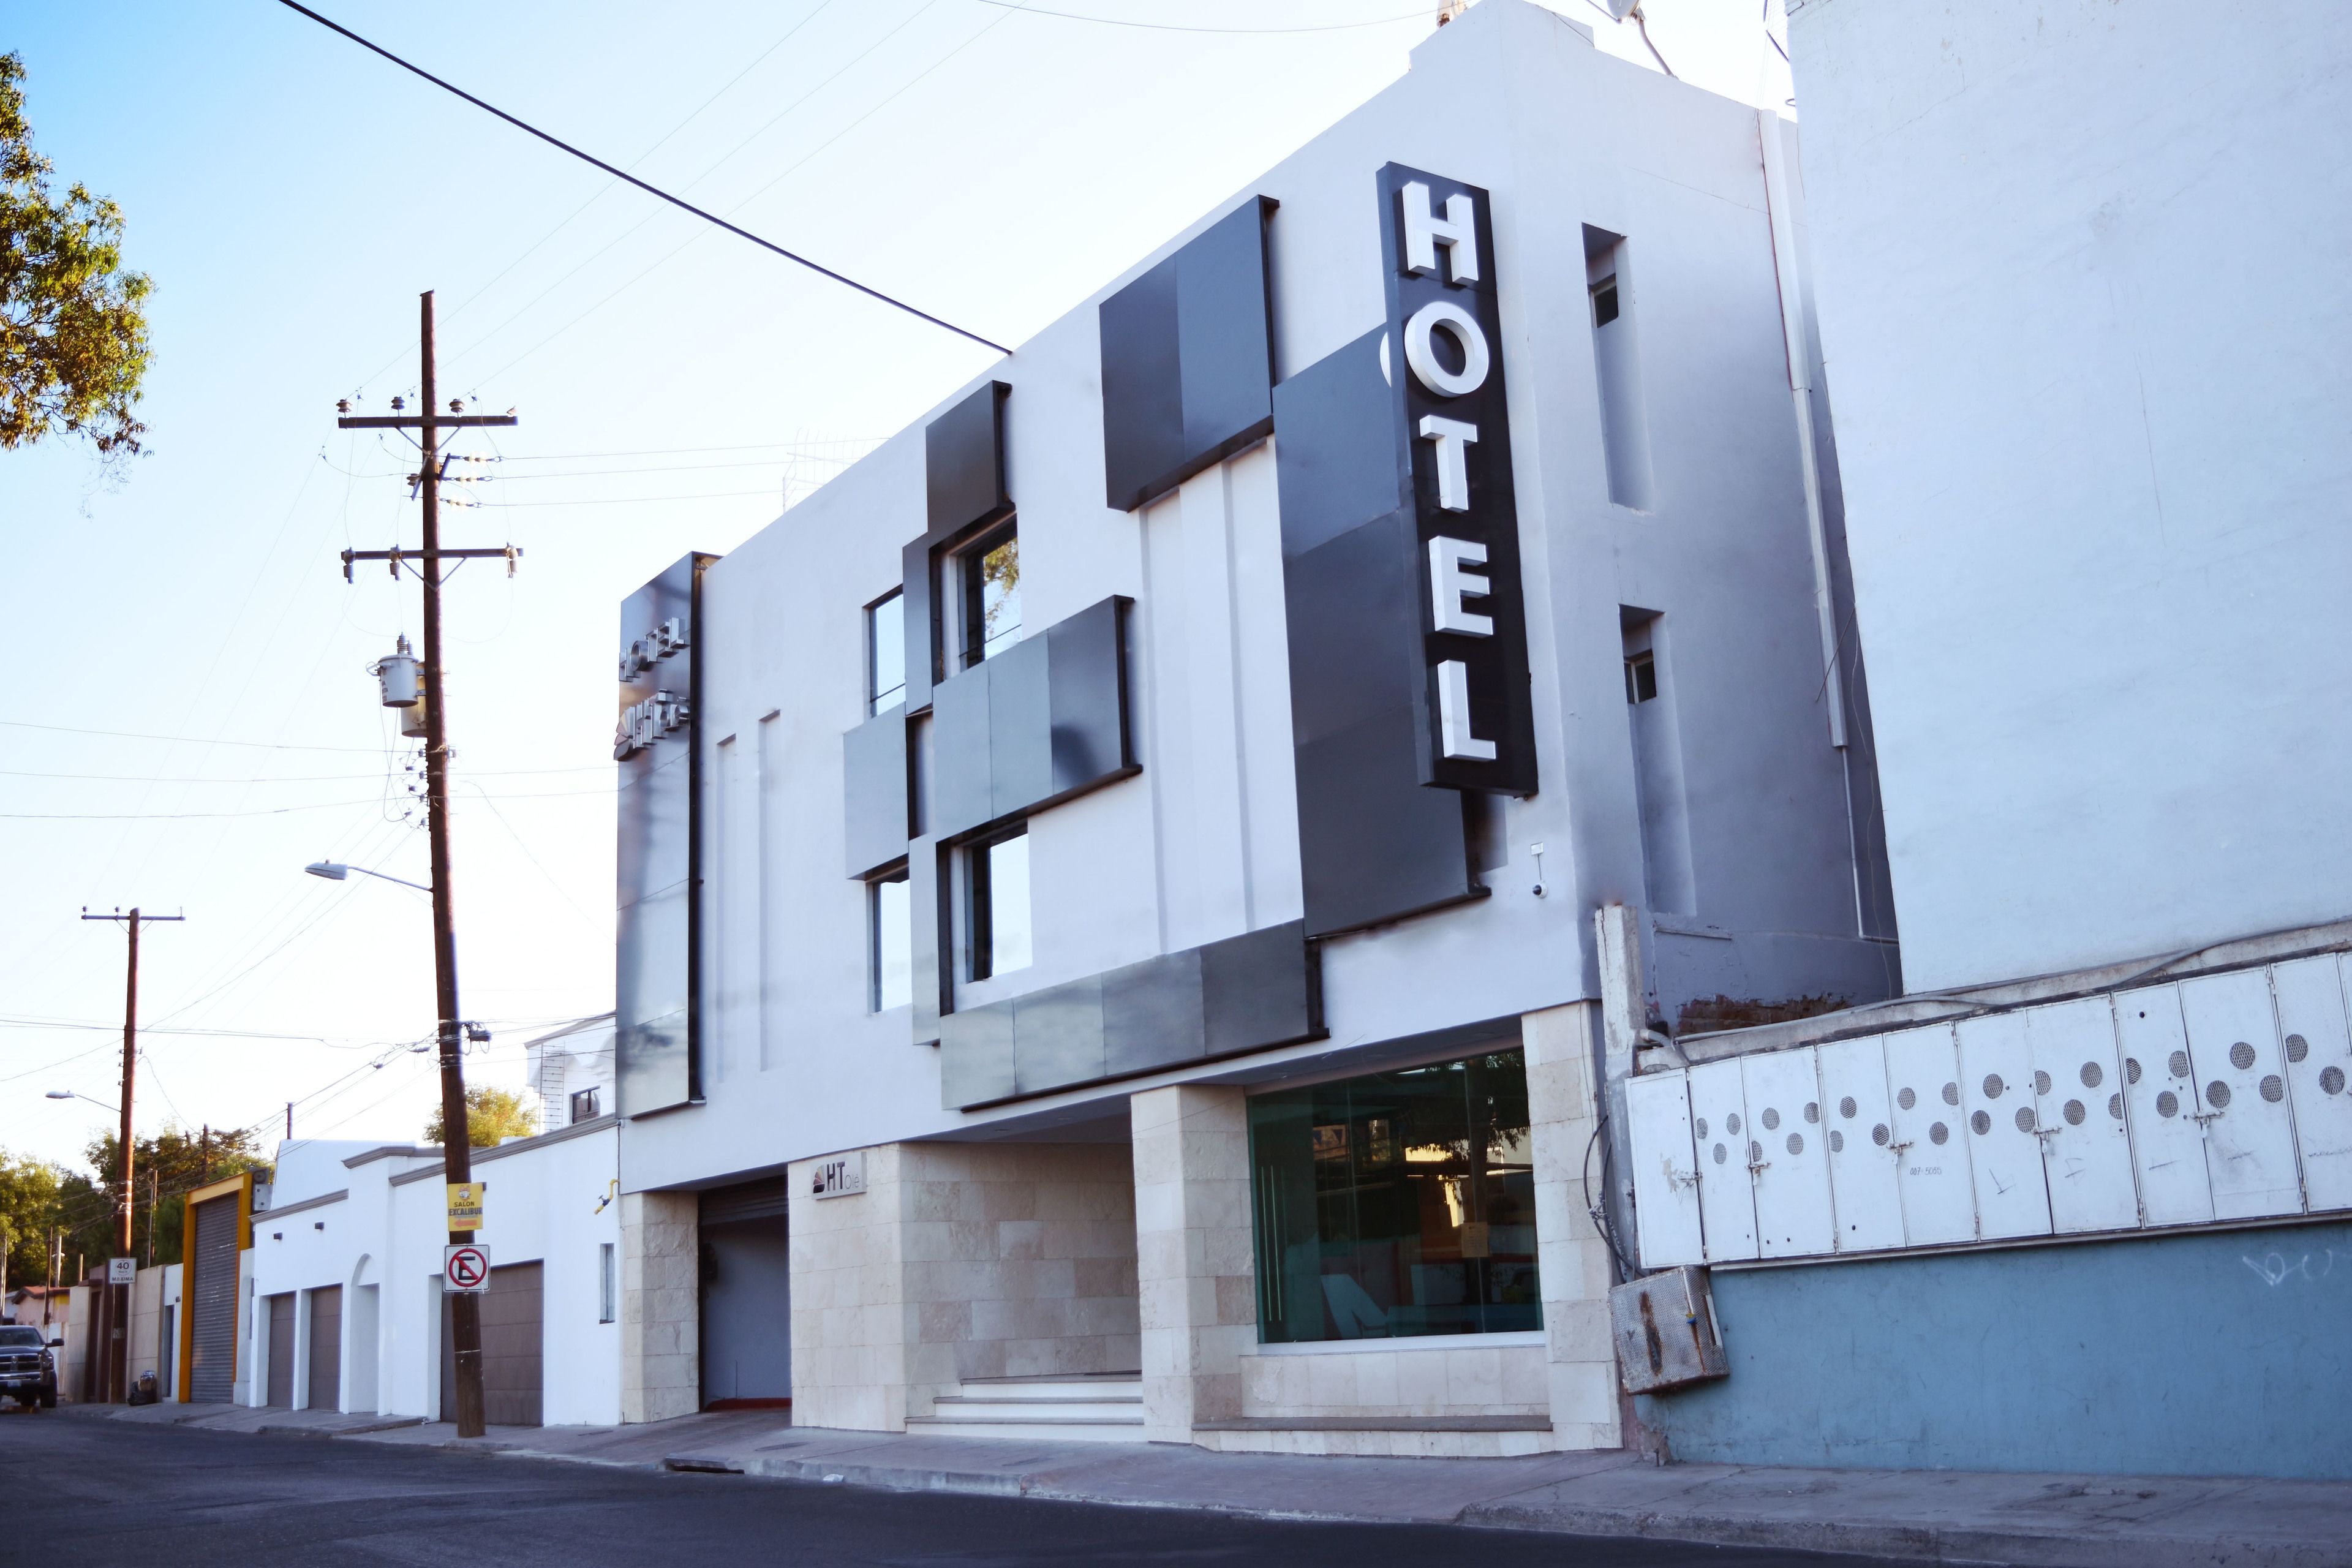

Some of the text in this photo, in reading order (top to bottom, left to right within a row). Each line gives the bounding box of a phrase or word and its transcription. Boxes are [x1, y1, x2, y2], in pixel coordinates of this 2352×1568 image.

[1401, 181, 1496, 761] HOTEL
[619, 617, 685, 682] HOTEL
[459, 1256, 477, 1280] E
